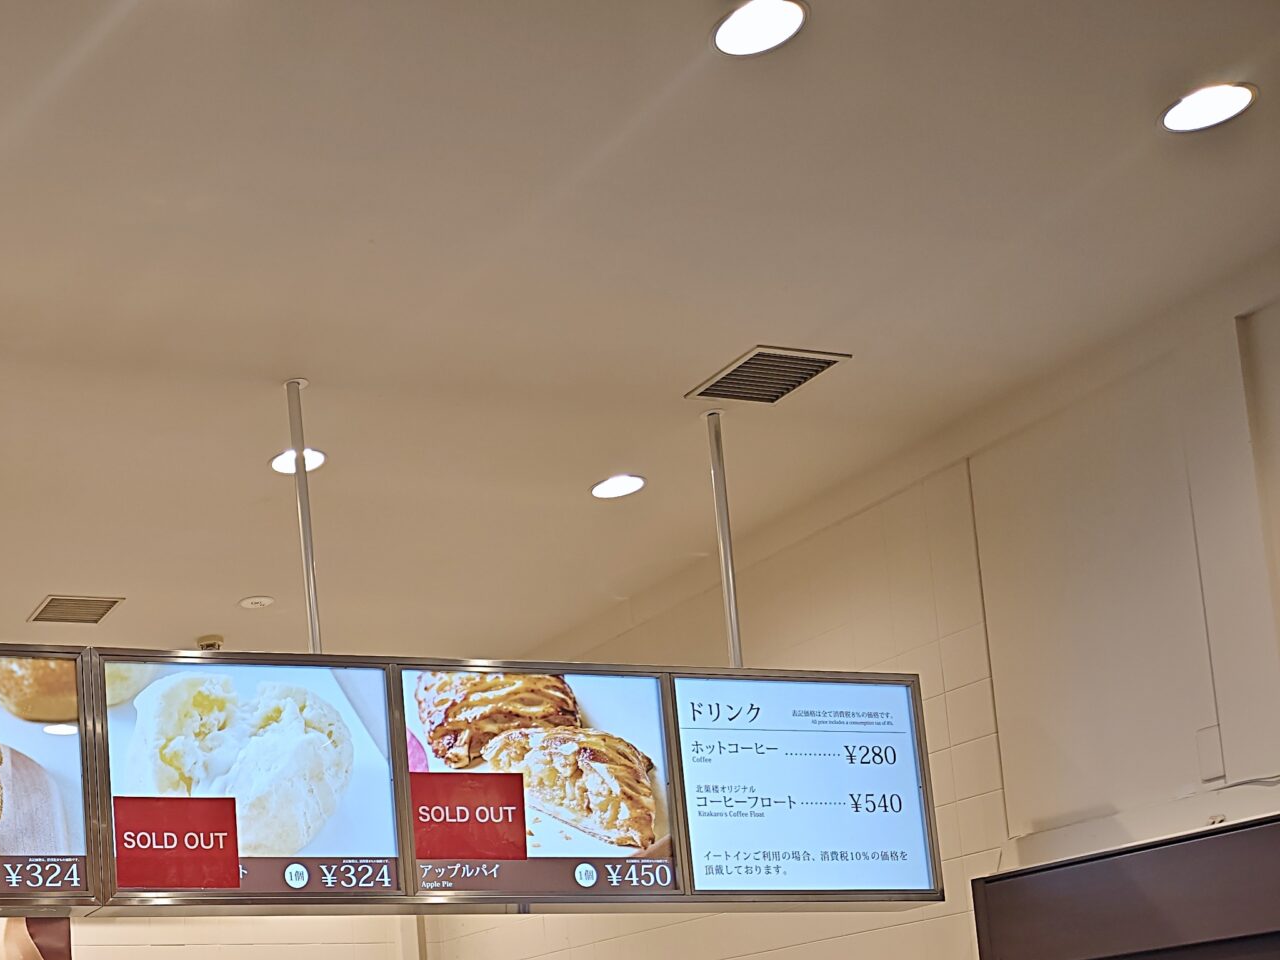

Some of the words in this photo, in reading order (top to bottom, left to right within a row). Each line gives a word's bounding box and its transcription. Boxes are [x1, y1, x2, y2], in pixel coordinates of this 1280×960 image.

[690, 702, 760, 723] ドリンク
[691, 741, 778, 755] ホットコーヒー
[843, 745, 897, 765] ¥280
[696, 784, 756, 793] 北菓楼オリジナル
[696, 795, 796, 809] コーヒーフロート
[849, 794, 902, 813] ¥540
[418, 806, 469, 823] SOLD
[475, 806, 516, 823] OUT
[123, 832, 177, 849] SOLD
[184, 832, 228, 850] OUT
[4, 863, 81, 887] ¥324
[289, 870, 305, 882] 1個
[320, 864, 391, 888] ¥324
[420, 863, 500, 878] アップルパイ
[605, 864, 671, 887] ¥450
[705, 864, 788, 876] 頂戴しております。
[421, 880, 441, 889] Apple
[442, 880, 453, 888] Pie
